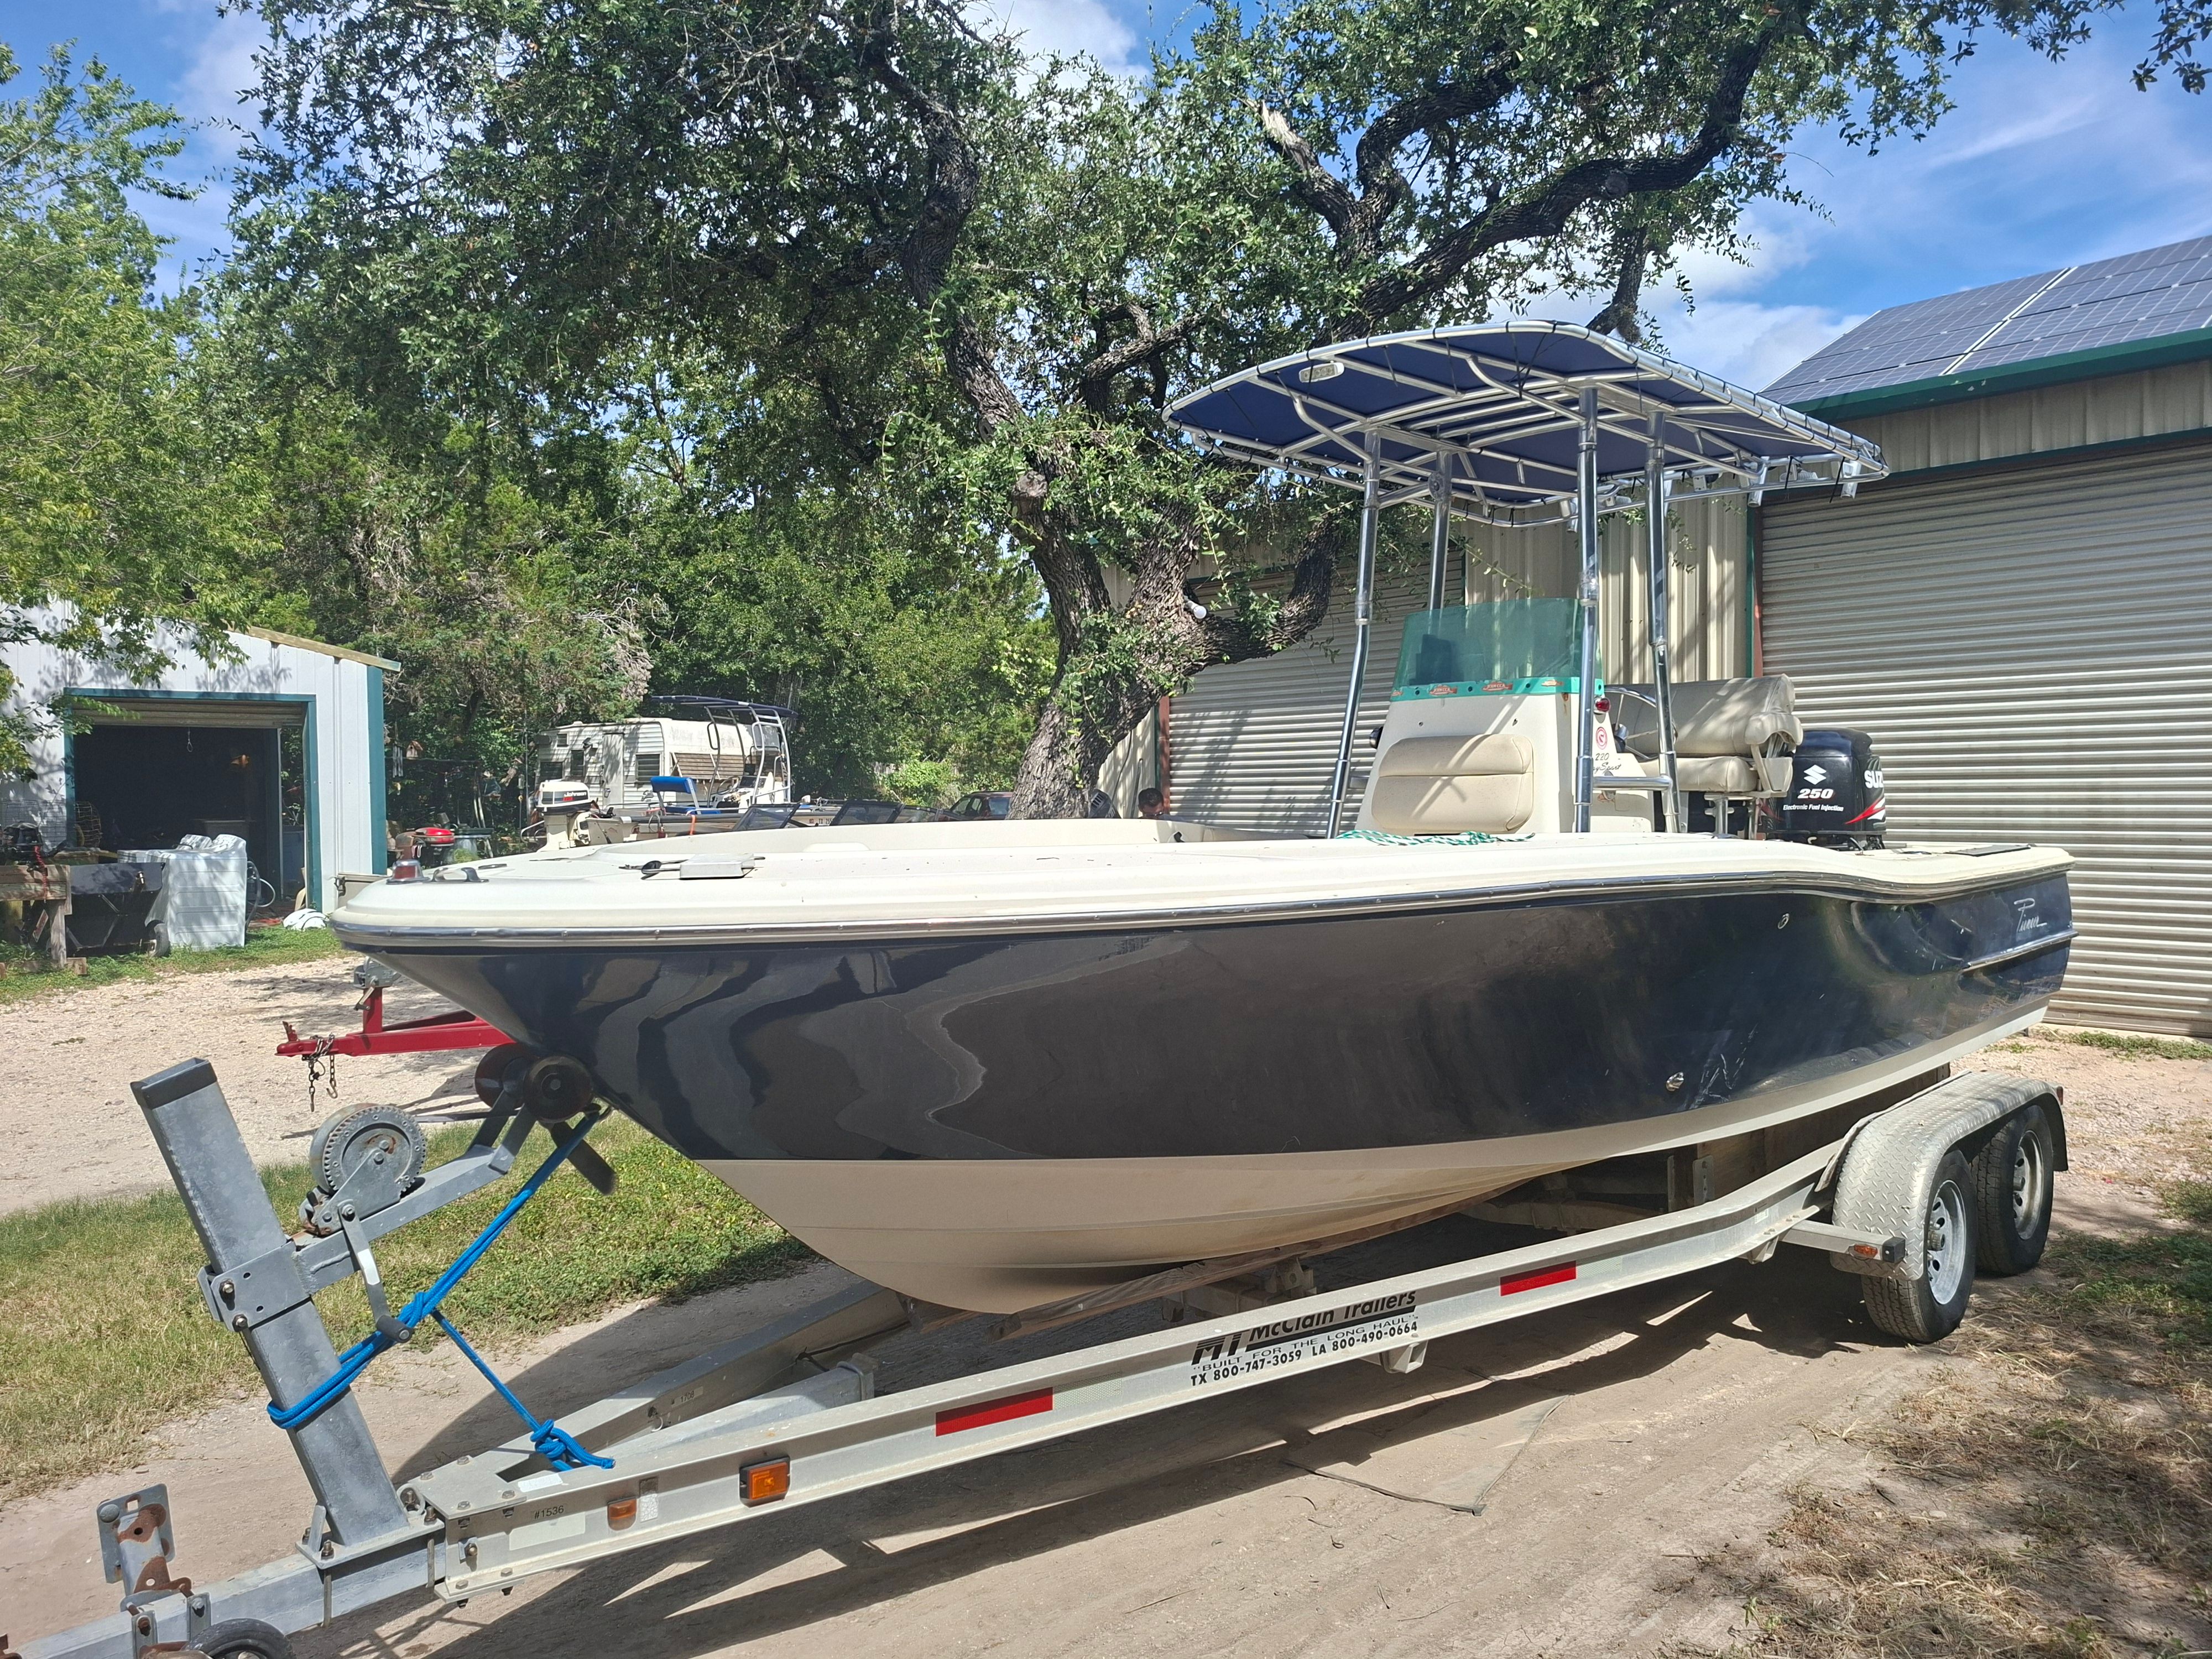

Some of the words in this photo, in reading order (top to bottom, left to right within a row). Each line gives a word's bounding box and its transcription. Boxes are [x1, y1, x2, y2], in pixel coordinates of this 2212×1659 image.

[1595, 753, 1609, 761] 220
[1797, 788, 1834, 799] 250
[1249, 1310, 1334, 1342] McClain
[1191, 1373, 1207, 1386] TX
[1213, 1349, 1302, 1381] 800-747-3059
[1312, 1344, 1327, 1356] LA
[1332, 1321, 1417, 1351] 800-490-0664
[1253, 1347, 1282, 1359] FOR
[1291, 1338, 1318, 1349] THE
[1327, 1327, 1365, 1341] LONG
